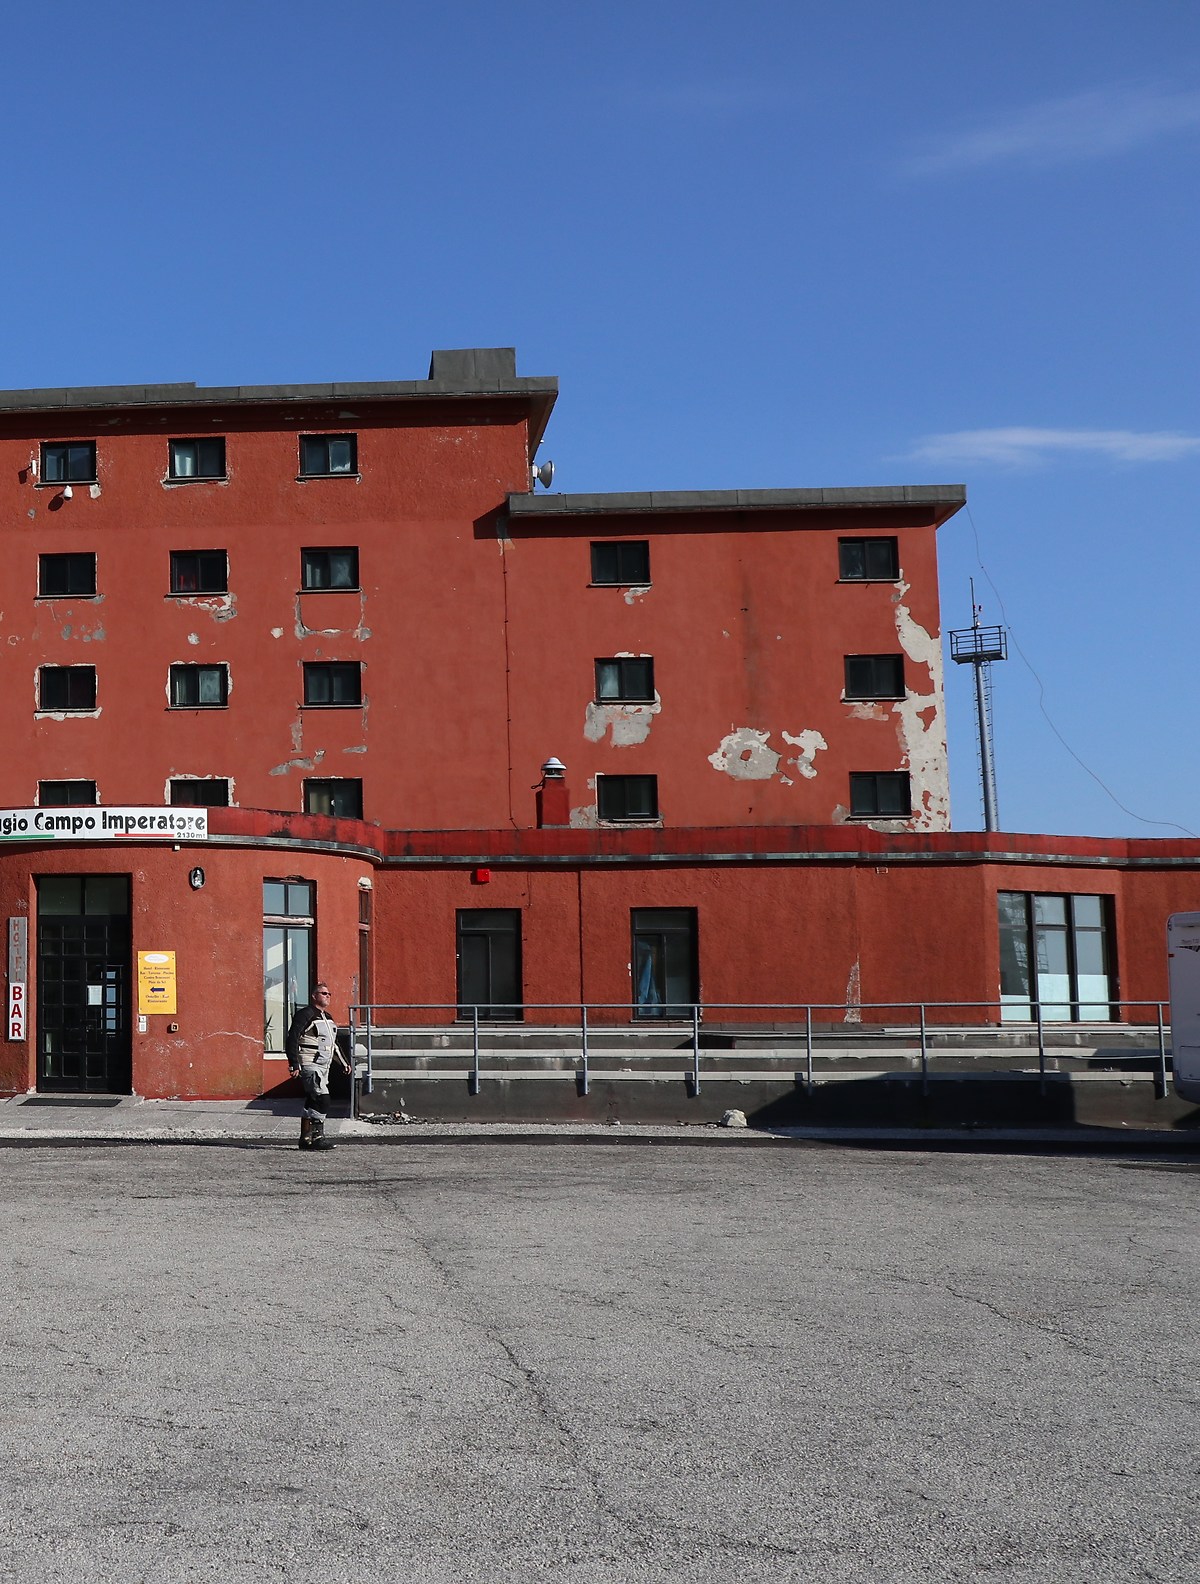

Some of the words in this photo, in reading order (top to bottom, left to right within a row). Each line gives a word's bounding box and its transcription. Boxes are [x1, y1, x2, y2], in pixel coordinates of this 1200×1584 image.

[34, 812, 96, 835] Campo
[102, 811, 205, 834] Imperatore
[11, 985, 23, 1037] BAR
